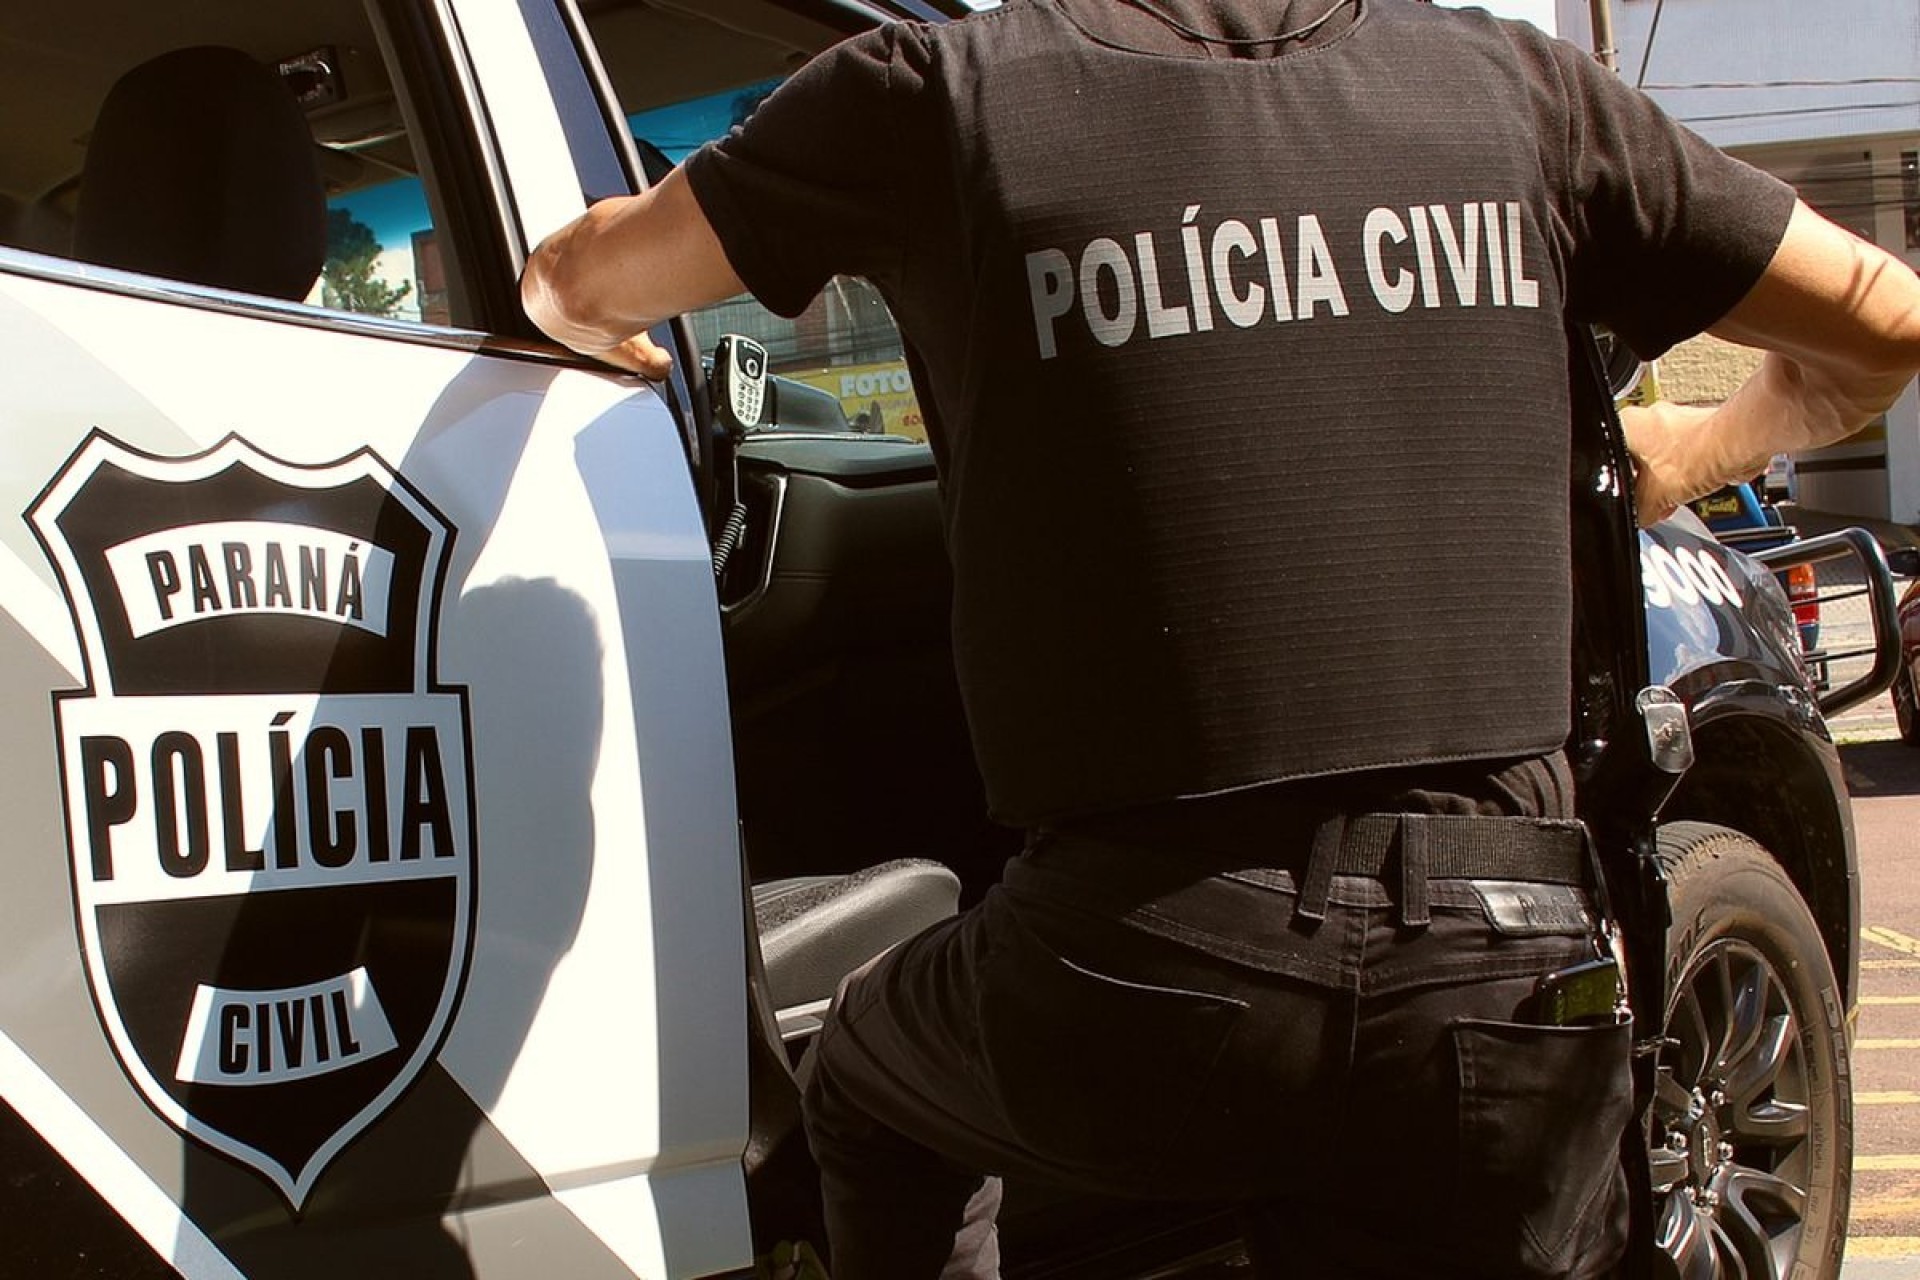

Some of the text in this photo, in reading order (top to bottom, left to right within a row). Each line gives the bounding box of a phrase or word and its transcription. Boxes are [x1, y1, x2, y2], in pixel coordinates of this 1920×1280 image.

[1025, 201, 1539, 360] POLÍCIA CIVIL
[840, 370, 912, 398] FOTO
[145, 541, 364, 621] PARANÁ
[80, 711, 456, 882] POLÍCIA
[218, 989, 361, 1074] CIVIL
